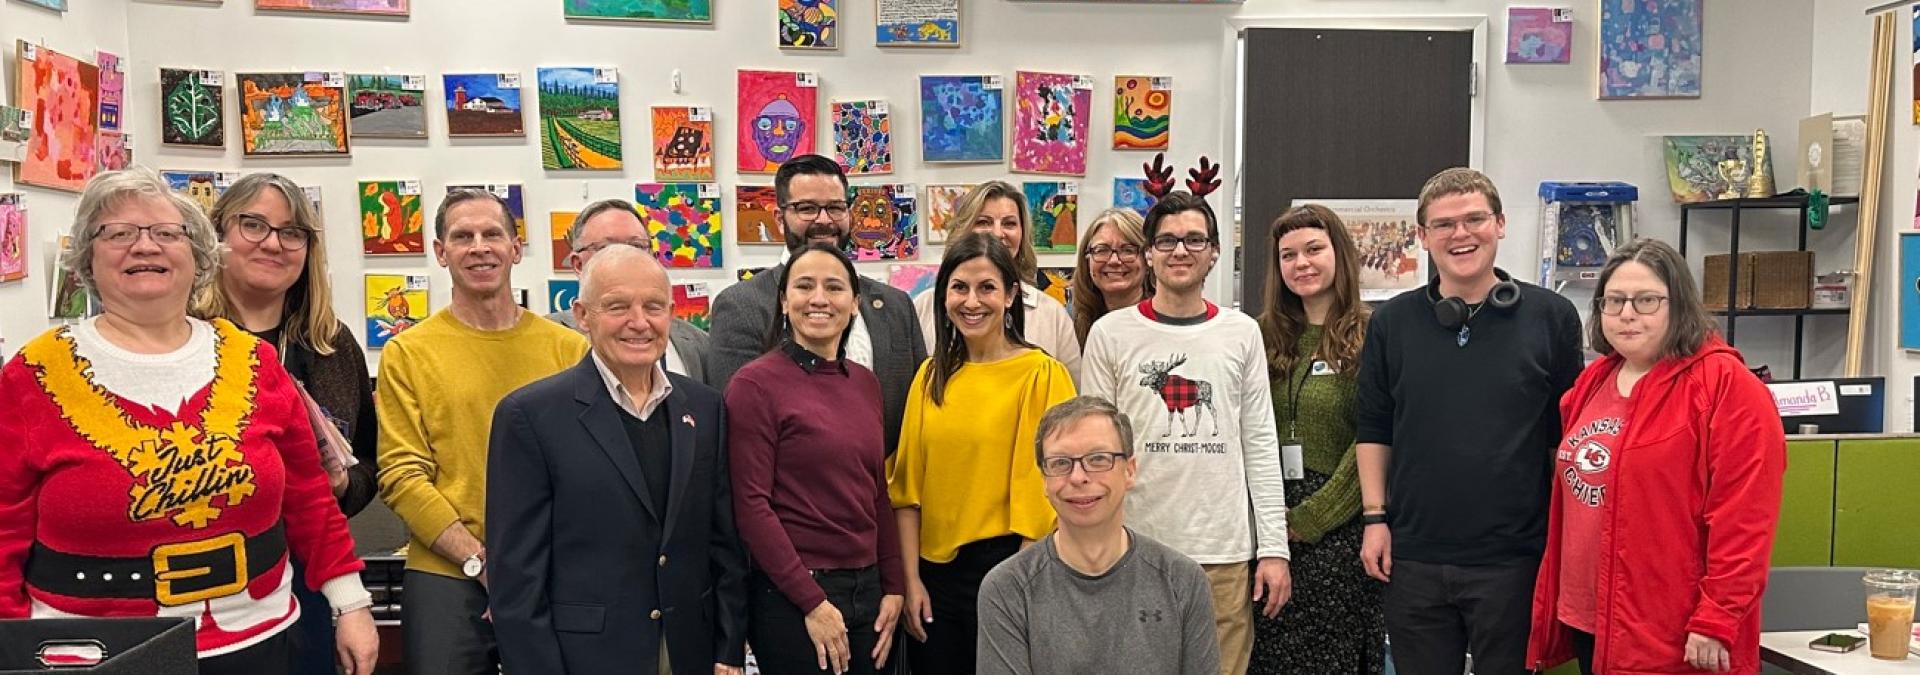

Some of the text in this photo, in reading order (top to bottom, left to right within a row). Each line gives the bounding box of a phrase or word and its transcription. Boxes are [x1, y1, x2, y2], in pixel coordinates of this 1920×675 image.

[151, 435, 227, 482] Just
[1145, 442, 1171, 453] MERRY
[133, 464, 249, 519] Chillin
[1564, 466, 1606, 507] CHIEF
